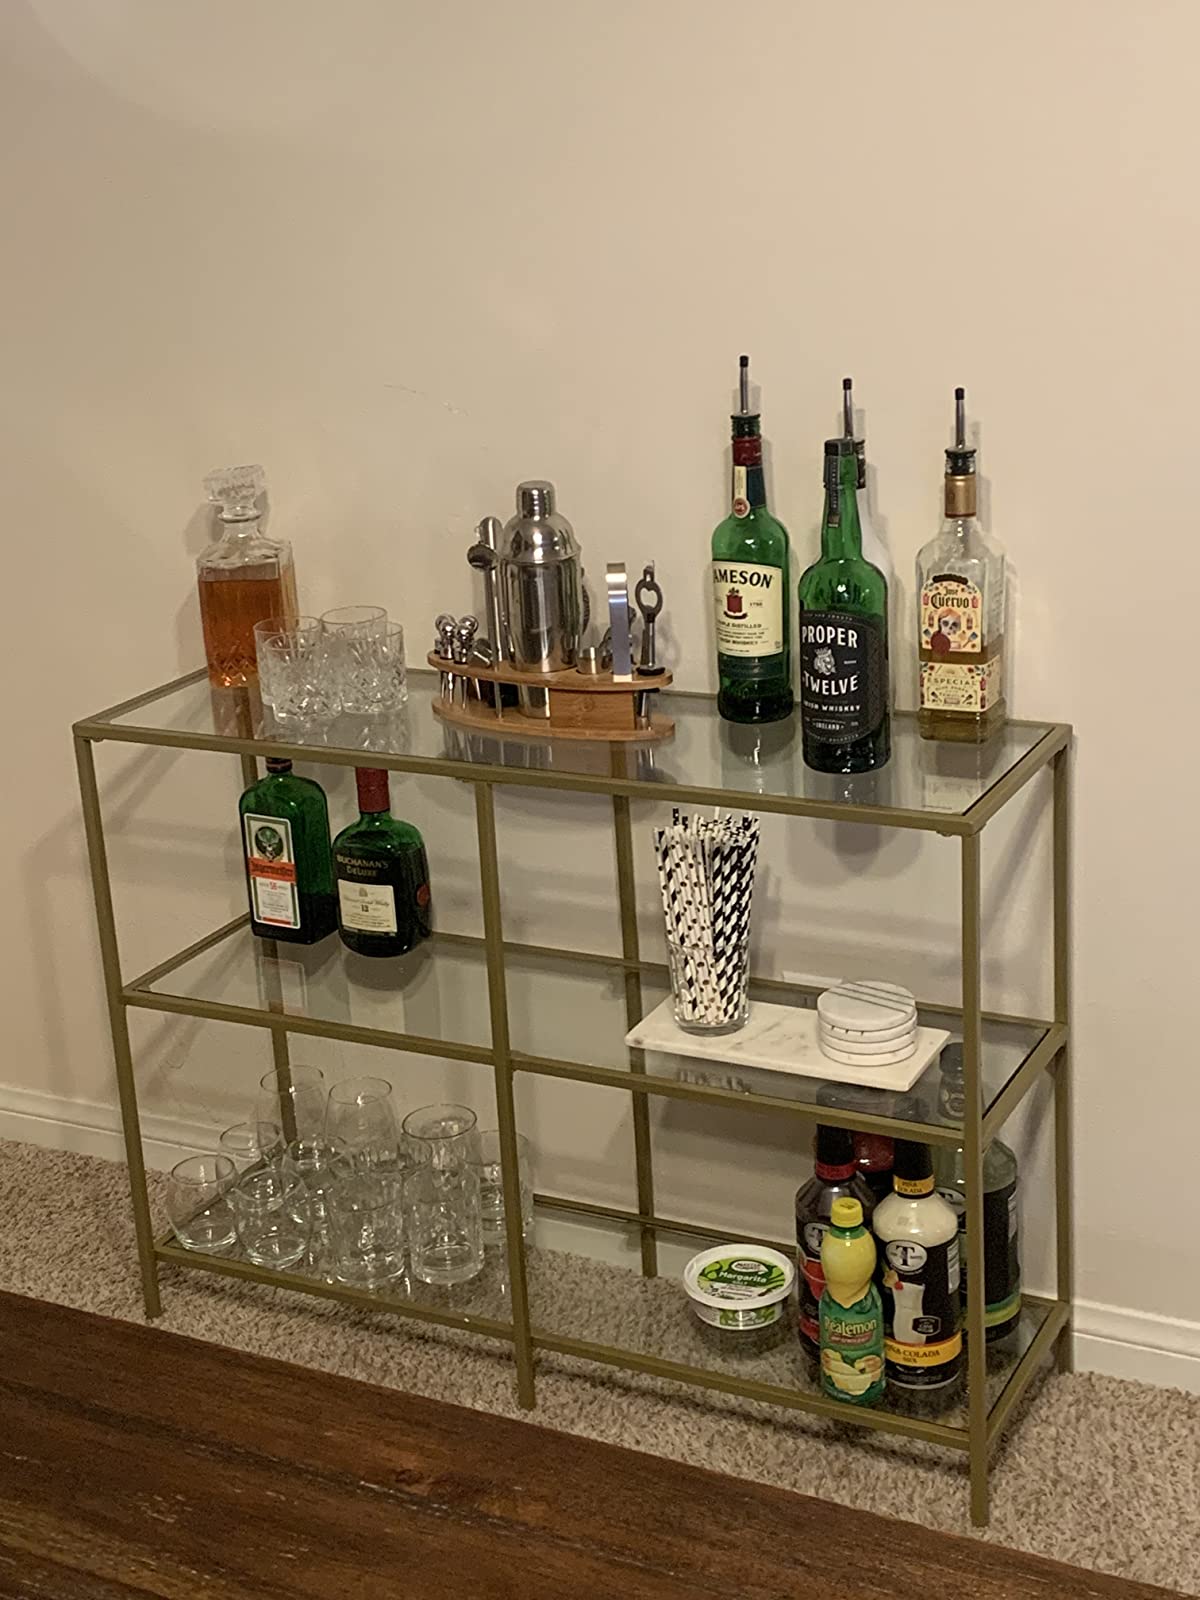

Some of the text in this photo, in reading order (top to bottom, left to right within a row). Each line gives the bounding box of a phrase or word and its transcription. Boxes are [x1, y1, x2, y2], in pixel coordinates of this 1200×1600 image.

[713, 569, 772, 589] AMESON
[930, 592, 970, 610] Cuervo
[801, 625, 858, 649] PROPER
[803, 671, 859, 696] TWELVE
[821, 704, 861, 712] WHISKEY
[718, 1270, 768, 1284] Margarita
[902, 1349, 941, 1359] COLADA
